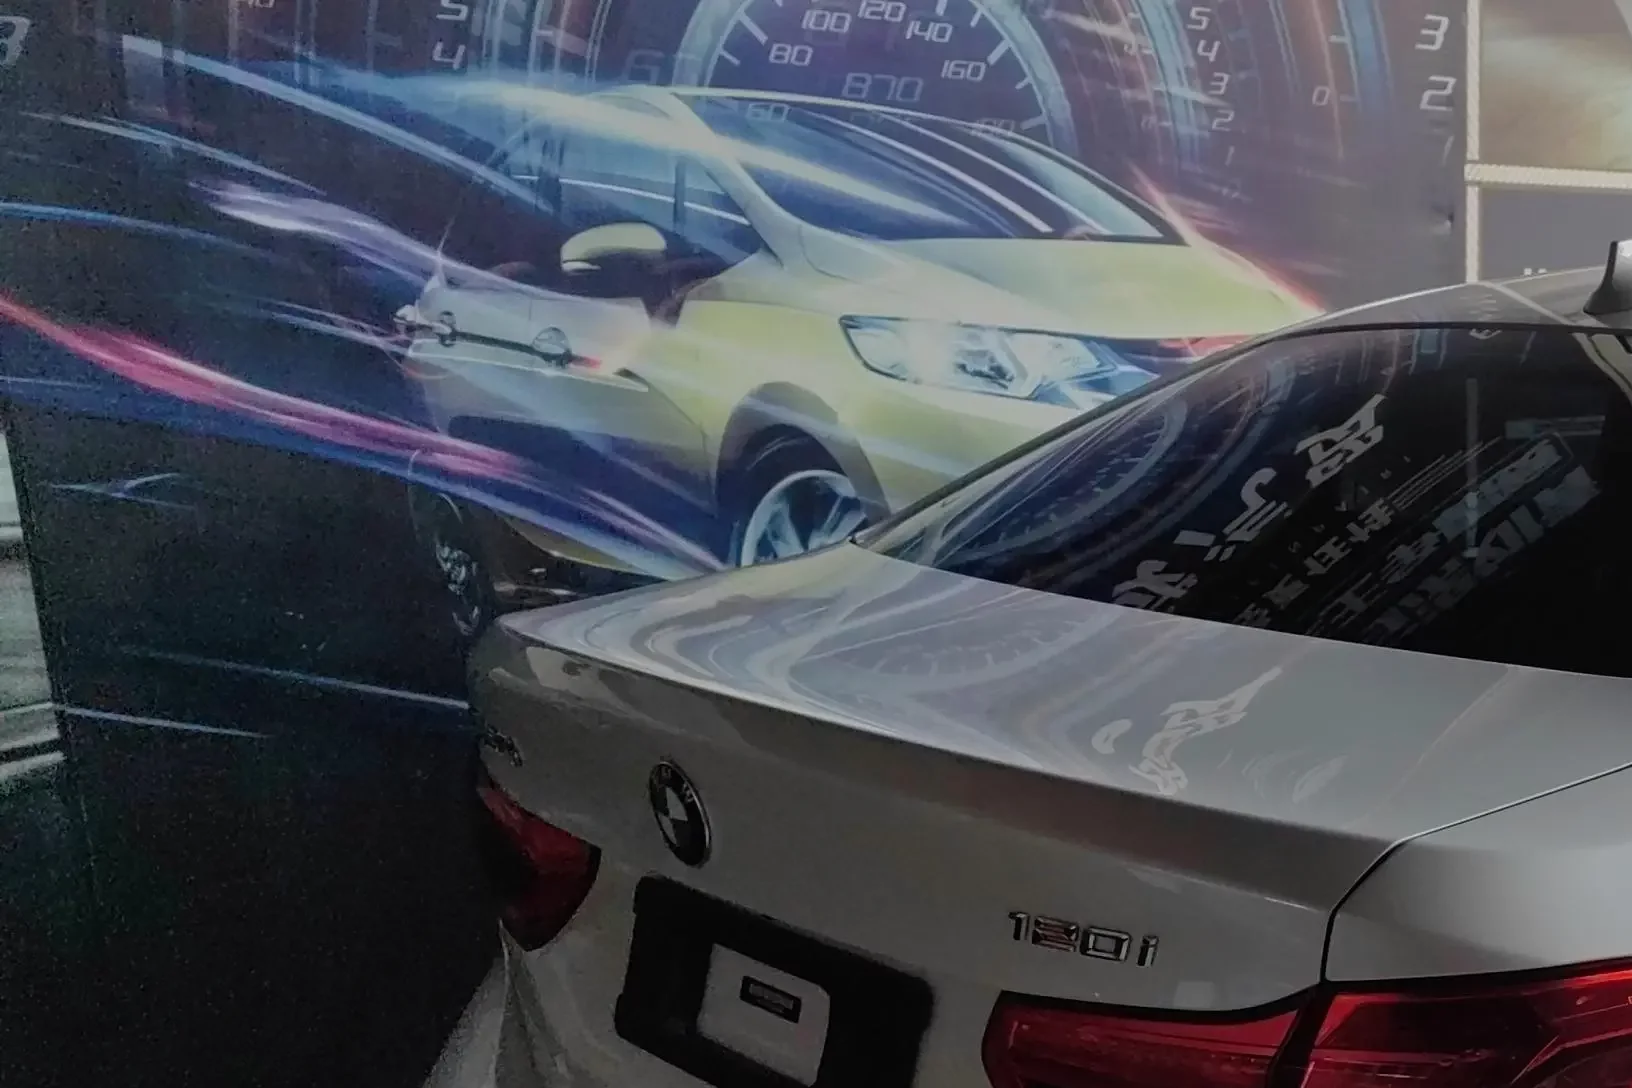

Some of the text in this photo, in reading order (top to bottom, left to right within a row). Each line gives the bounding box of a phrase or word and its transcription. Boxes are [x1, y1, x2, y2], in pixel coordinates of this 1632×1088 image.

[801, 9, 852, 33] 100
[1186, 6, 1212, 31] 5
[905, 20, 953, 43] 140
[1415, 13, 1449, 51] 3
[433, 41, 466, 70] 4
[768, 43, 813, 67] 80
[1196, 39, 1221, 62] 4
[941, 59, 987, 82] 160
[842, 72, 923, 102] 870
[1208, 71, 1231, 95] 3
[1419, 75, 1456, 111] 2
[1211, 109, 1235, 132] 2
[1008, 911, 1159, 967] 120i
